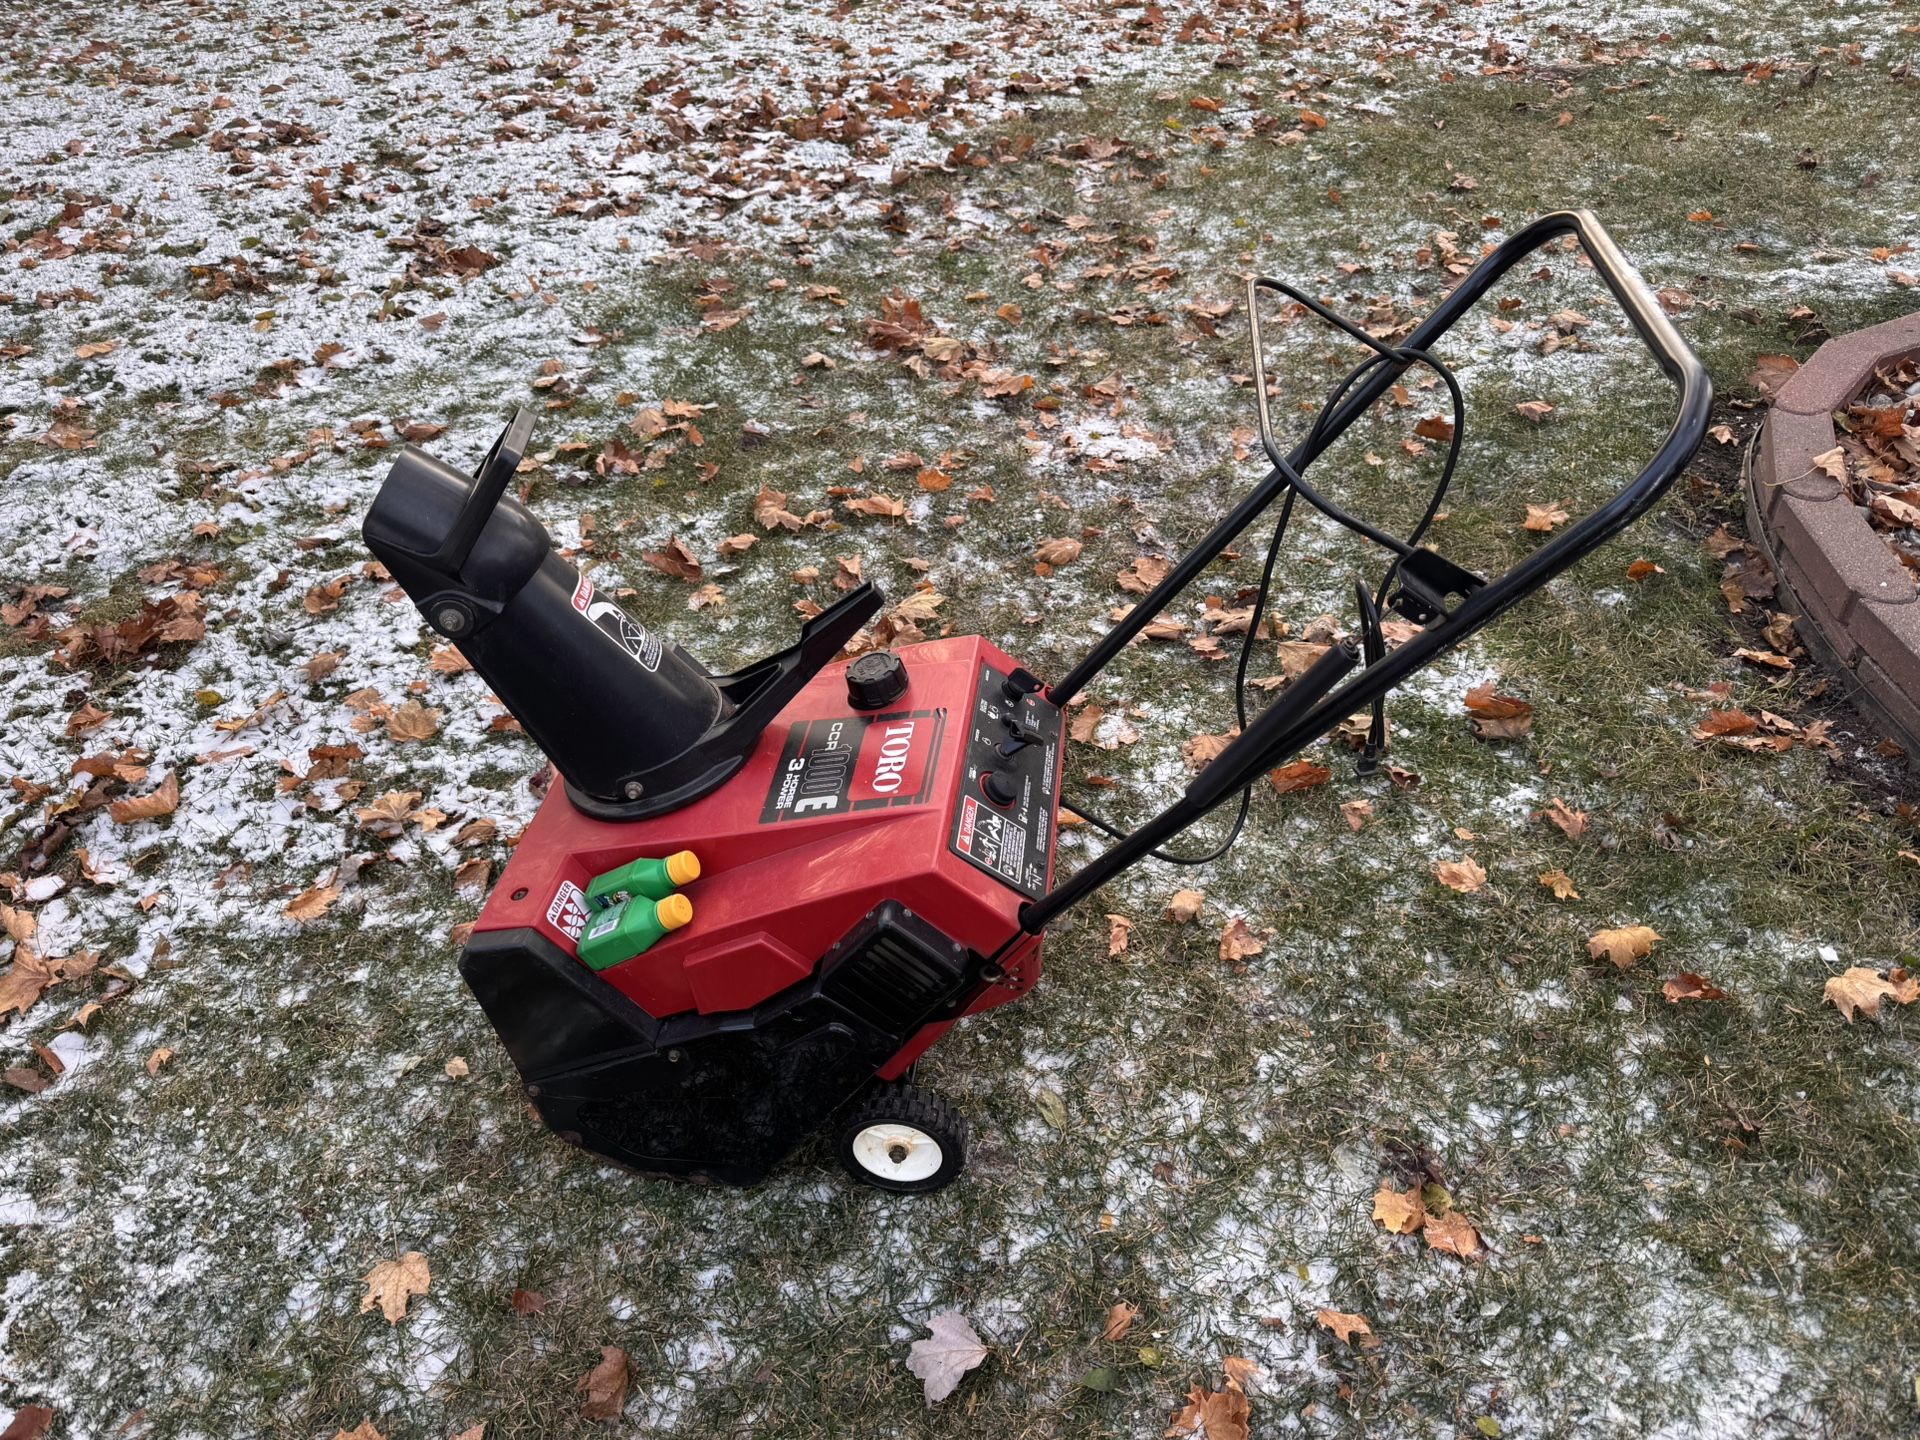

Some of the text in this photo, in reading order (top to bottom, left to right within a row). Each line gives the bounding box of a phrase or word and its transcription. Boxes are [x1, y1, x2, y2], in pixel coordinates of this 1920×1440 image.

[794, 722, 852, 813] CCR 1000E
[872, 721, 915, 793] TORO
[775, 773, 794, 810] POWER
[784, 757, 805, 809] 3 HORSE
[964, 805, 975, 834] DANGER
[553, 881, 572, 914] DANGER
